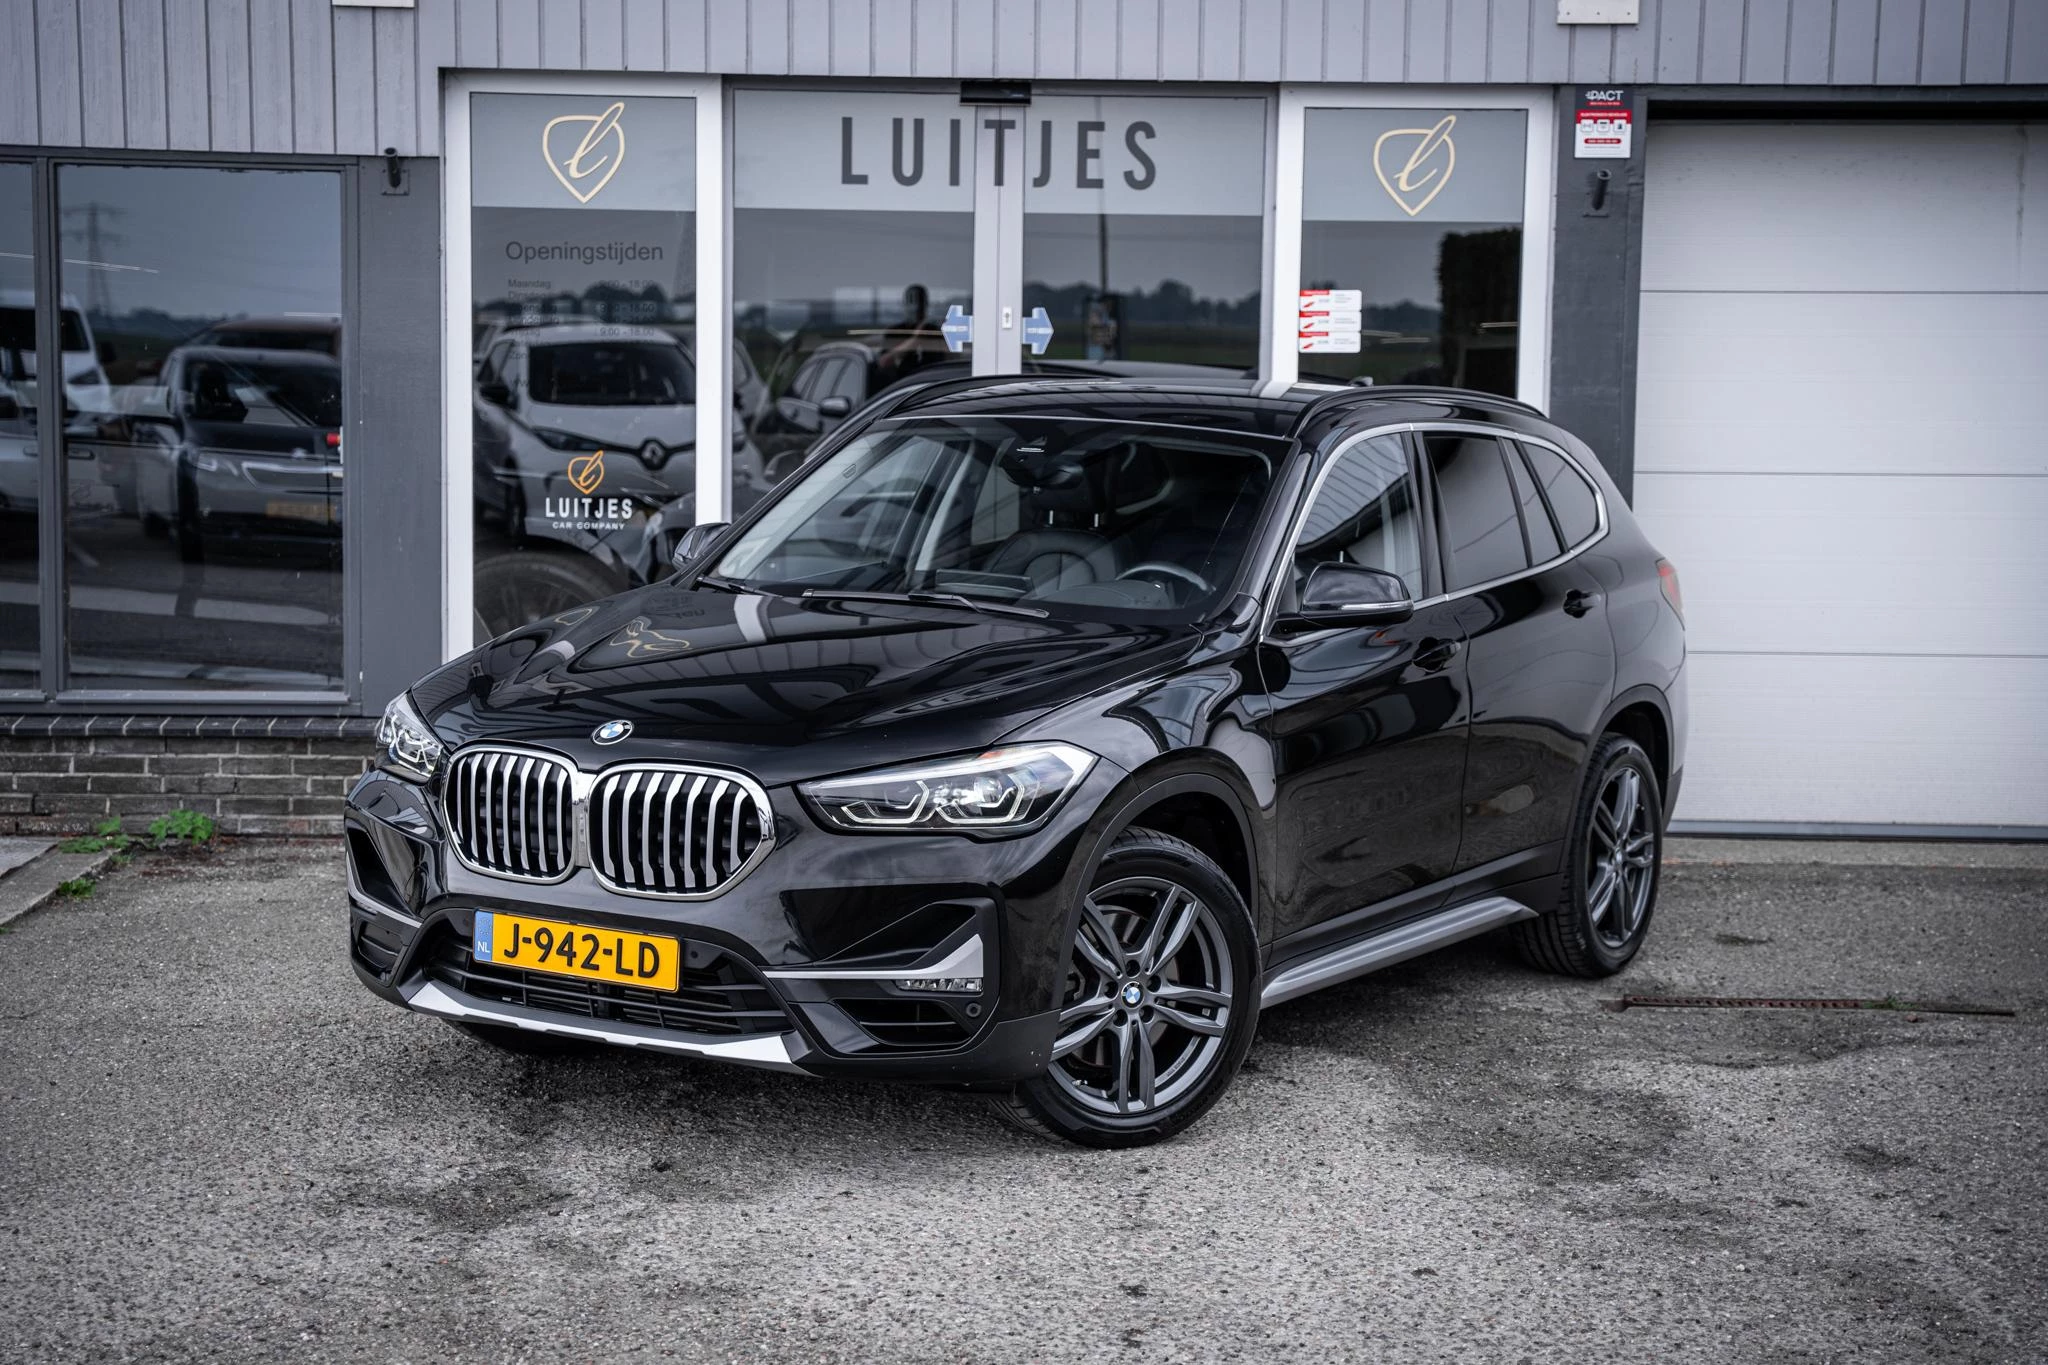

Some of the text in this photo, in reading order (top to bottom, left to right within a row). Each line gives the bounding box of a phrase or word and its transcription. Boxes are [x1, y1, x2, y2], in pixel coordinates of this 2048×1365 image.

[842, 117, 1156, 190] LUITJES
[506, 241, 663, 265] Openingstijden
[545, 497, 633, 519] LUITJES
[576, 522, 625, 530] COMPANY
[477, 942, 490, 953] NL
[504, 923, 660, 978] J-942-LD
